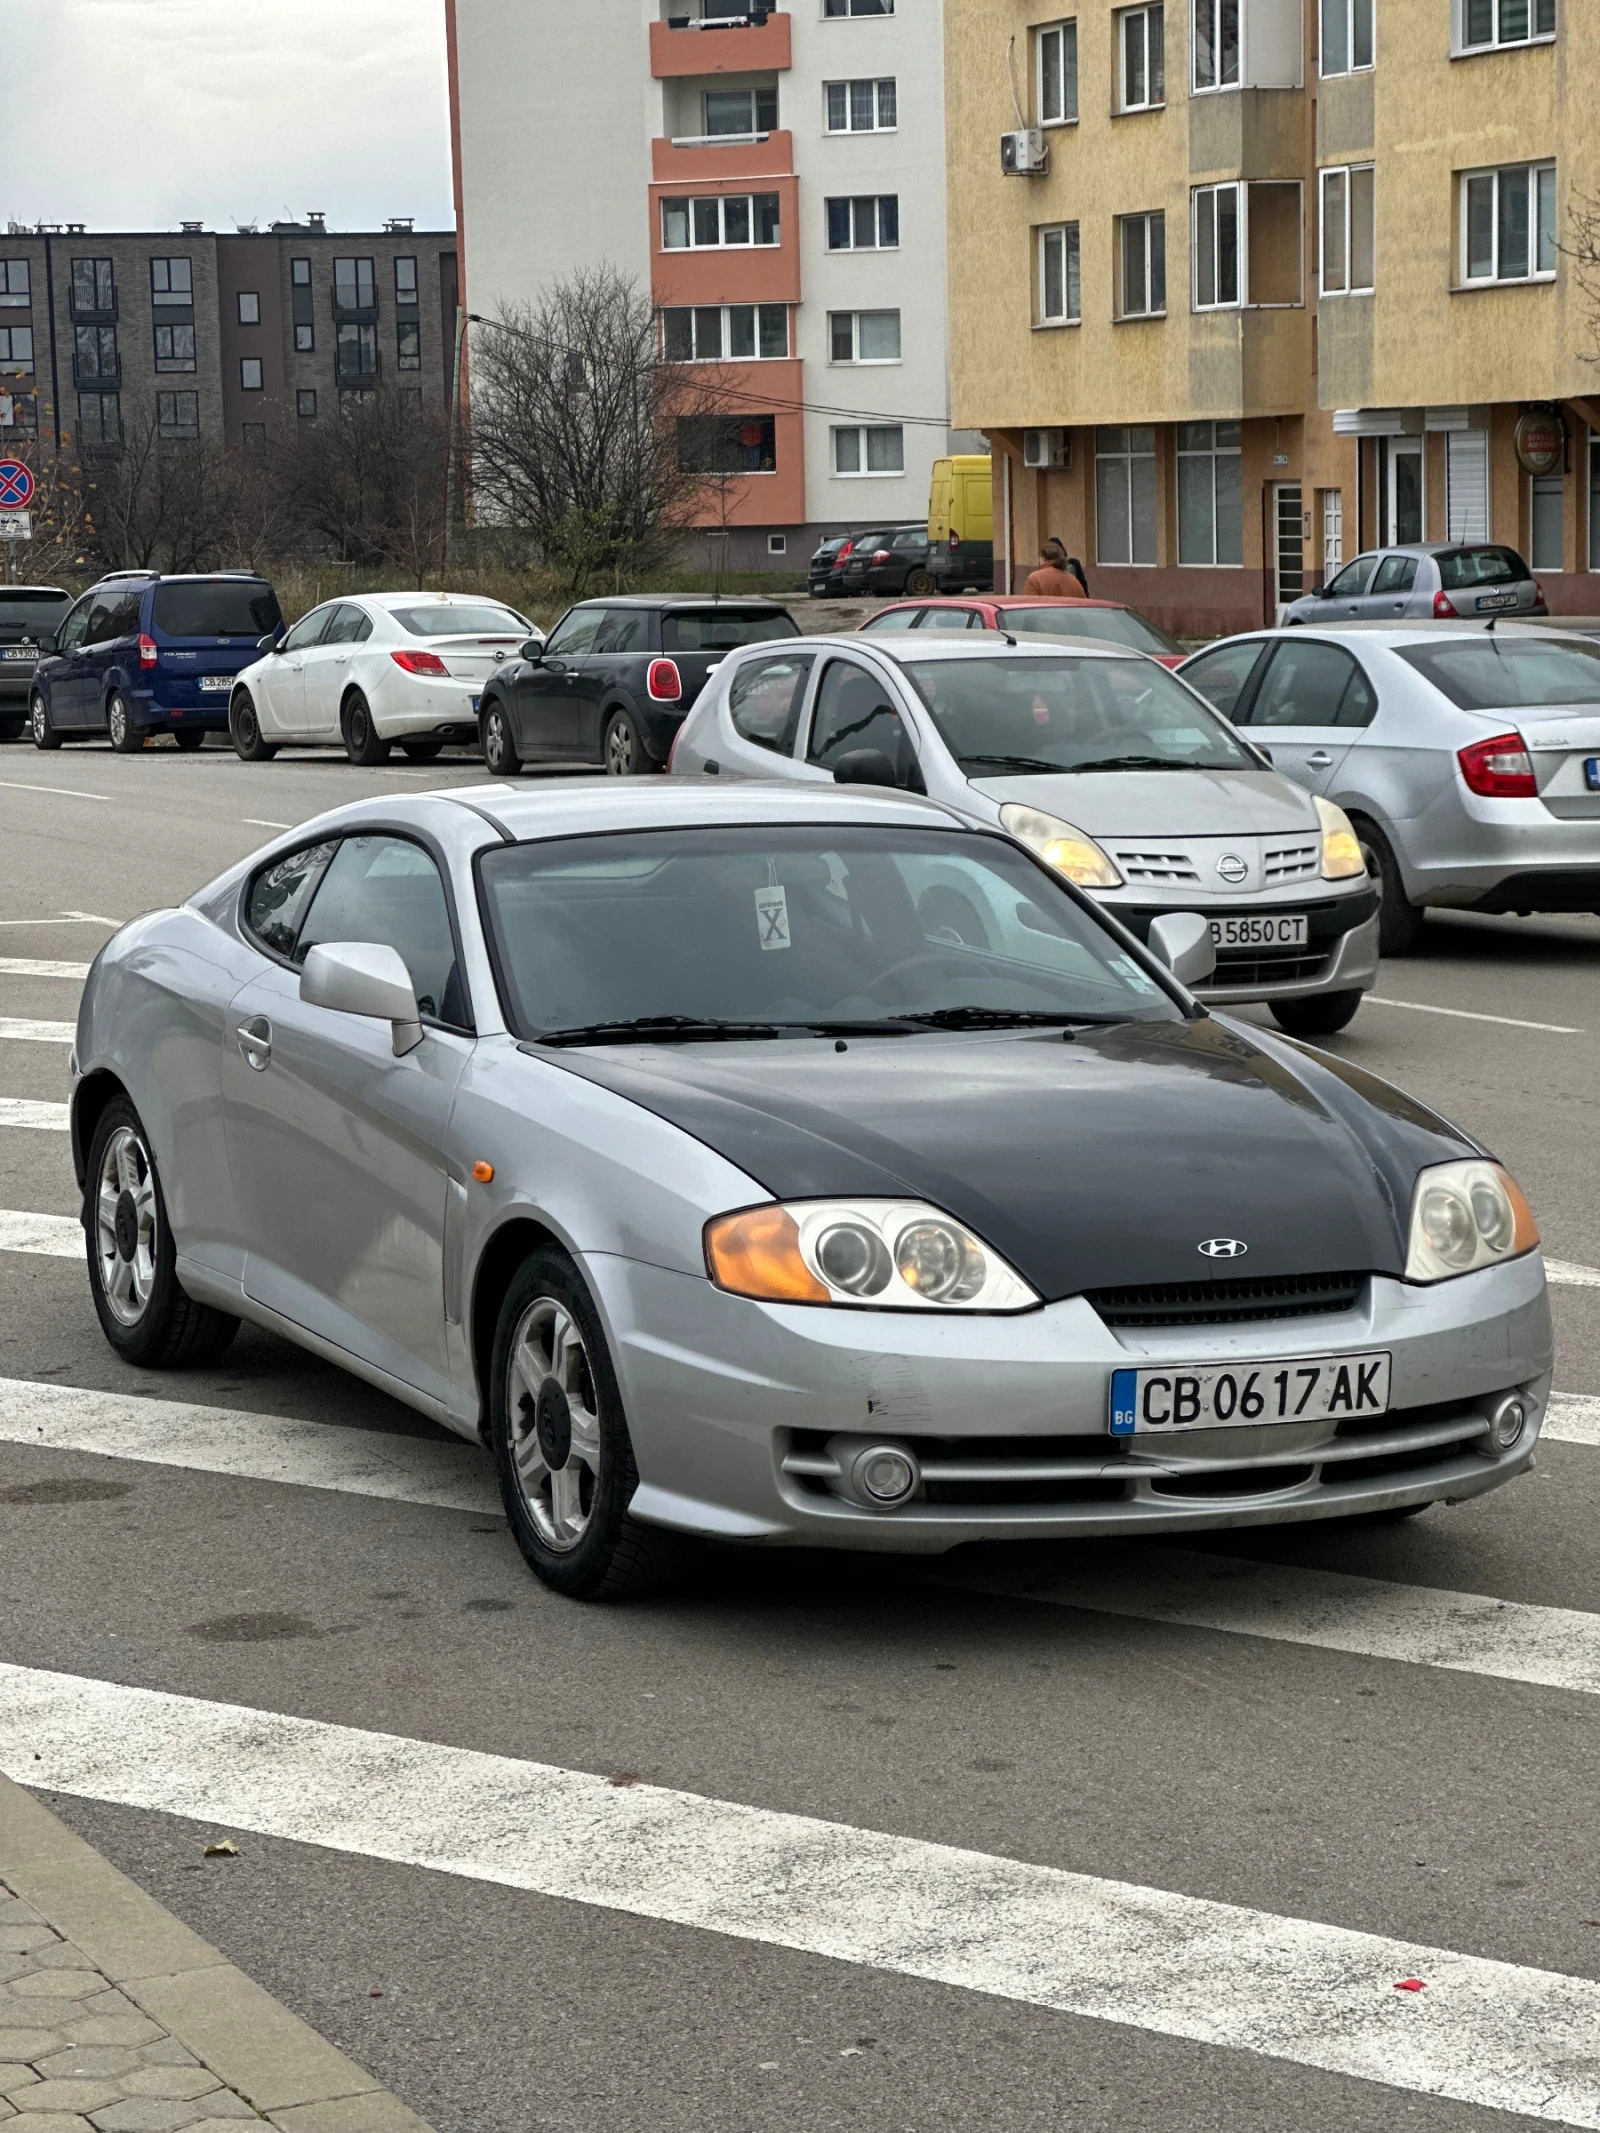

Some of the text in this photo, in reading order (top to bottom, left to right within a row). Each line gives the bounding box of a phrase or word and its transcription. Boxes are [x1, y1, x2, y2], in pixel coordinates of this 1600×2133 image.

[760, 908, 787, 940] X
[1226, 920, 1274, 943] 5850
[1278, 919, 1304, 941] CT
[1143, 1361, 1382, 1424] CB 0617 AK
[1114, 1410, 1134, 1425] BG
